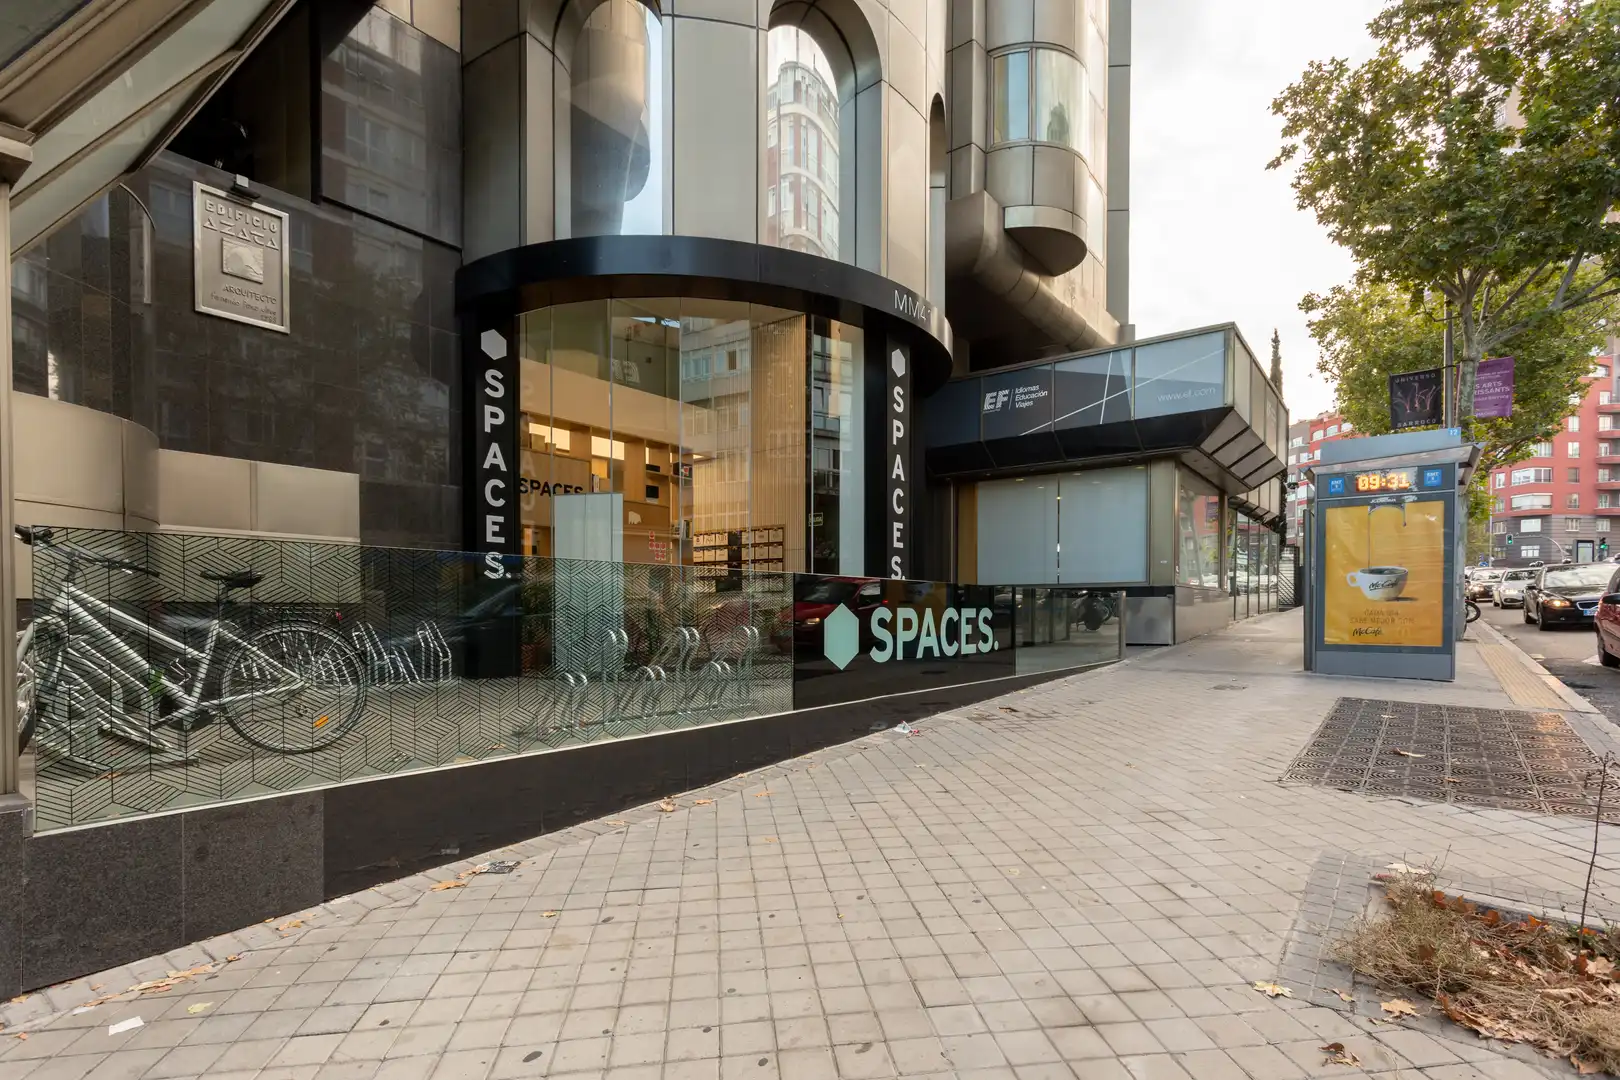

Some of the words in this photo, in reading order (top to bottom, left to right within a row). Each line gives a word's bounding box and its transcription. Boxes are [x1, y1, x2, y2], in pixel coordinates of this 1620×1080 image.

[205, 200, 278, 233] EDIFICIO
[203, 216, 279, 250] AZATA
[222, 284, 277, 305] ARQUITECTO
[1395, 372, 1437, 383] UNIVERSO
[1482, 380, 1503, 389] ARTS
[1015, 384, 1040, 394] Idiomas
[1015, 390, 1048, 401] Educación
[1157, 386, 1216, 402] www.ef.com
[983, 389, 1010, 411] EF
[1015, 400, 1033, 409] Viajes
[1397, 418, 1437, 428] BARROCO
[482, 368, 512, 580] SPACES.
[1357, 471, 1410, 491] 09:31
[869, 606, 999, 663] SPACES.
